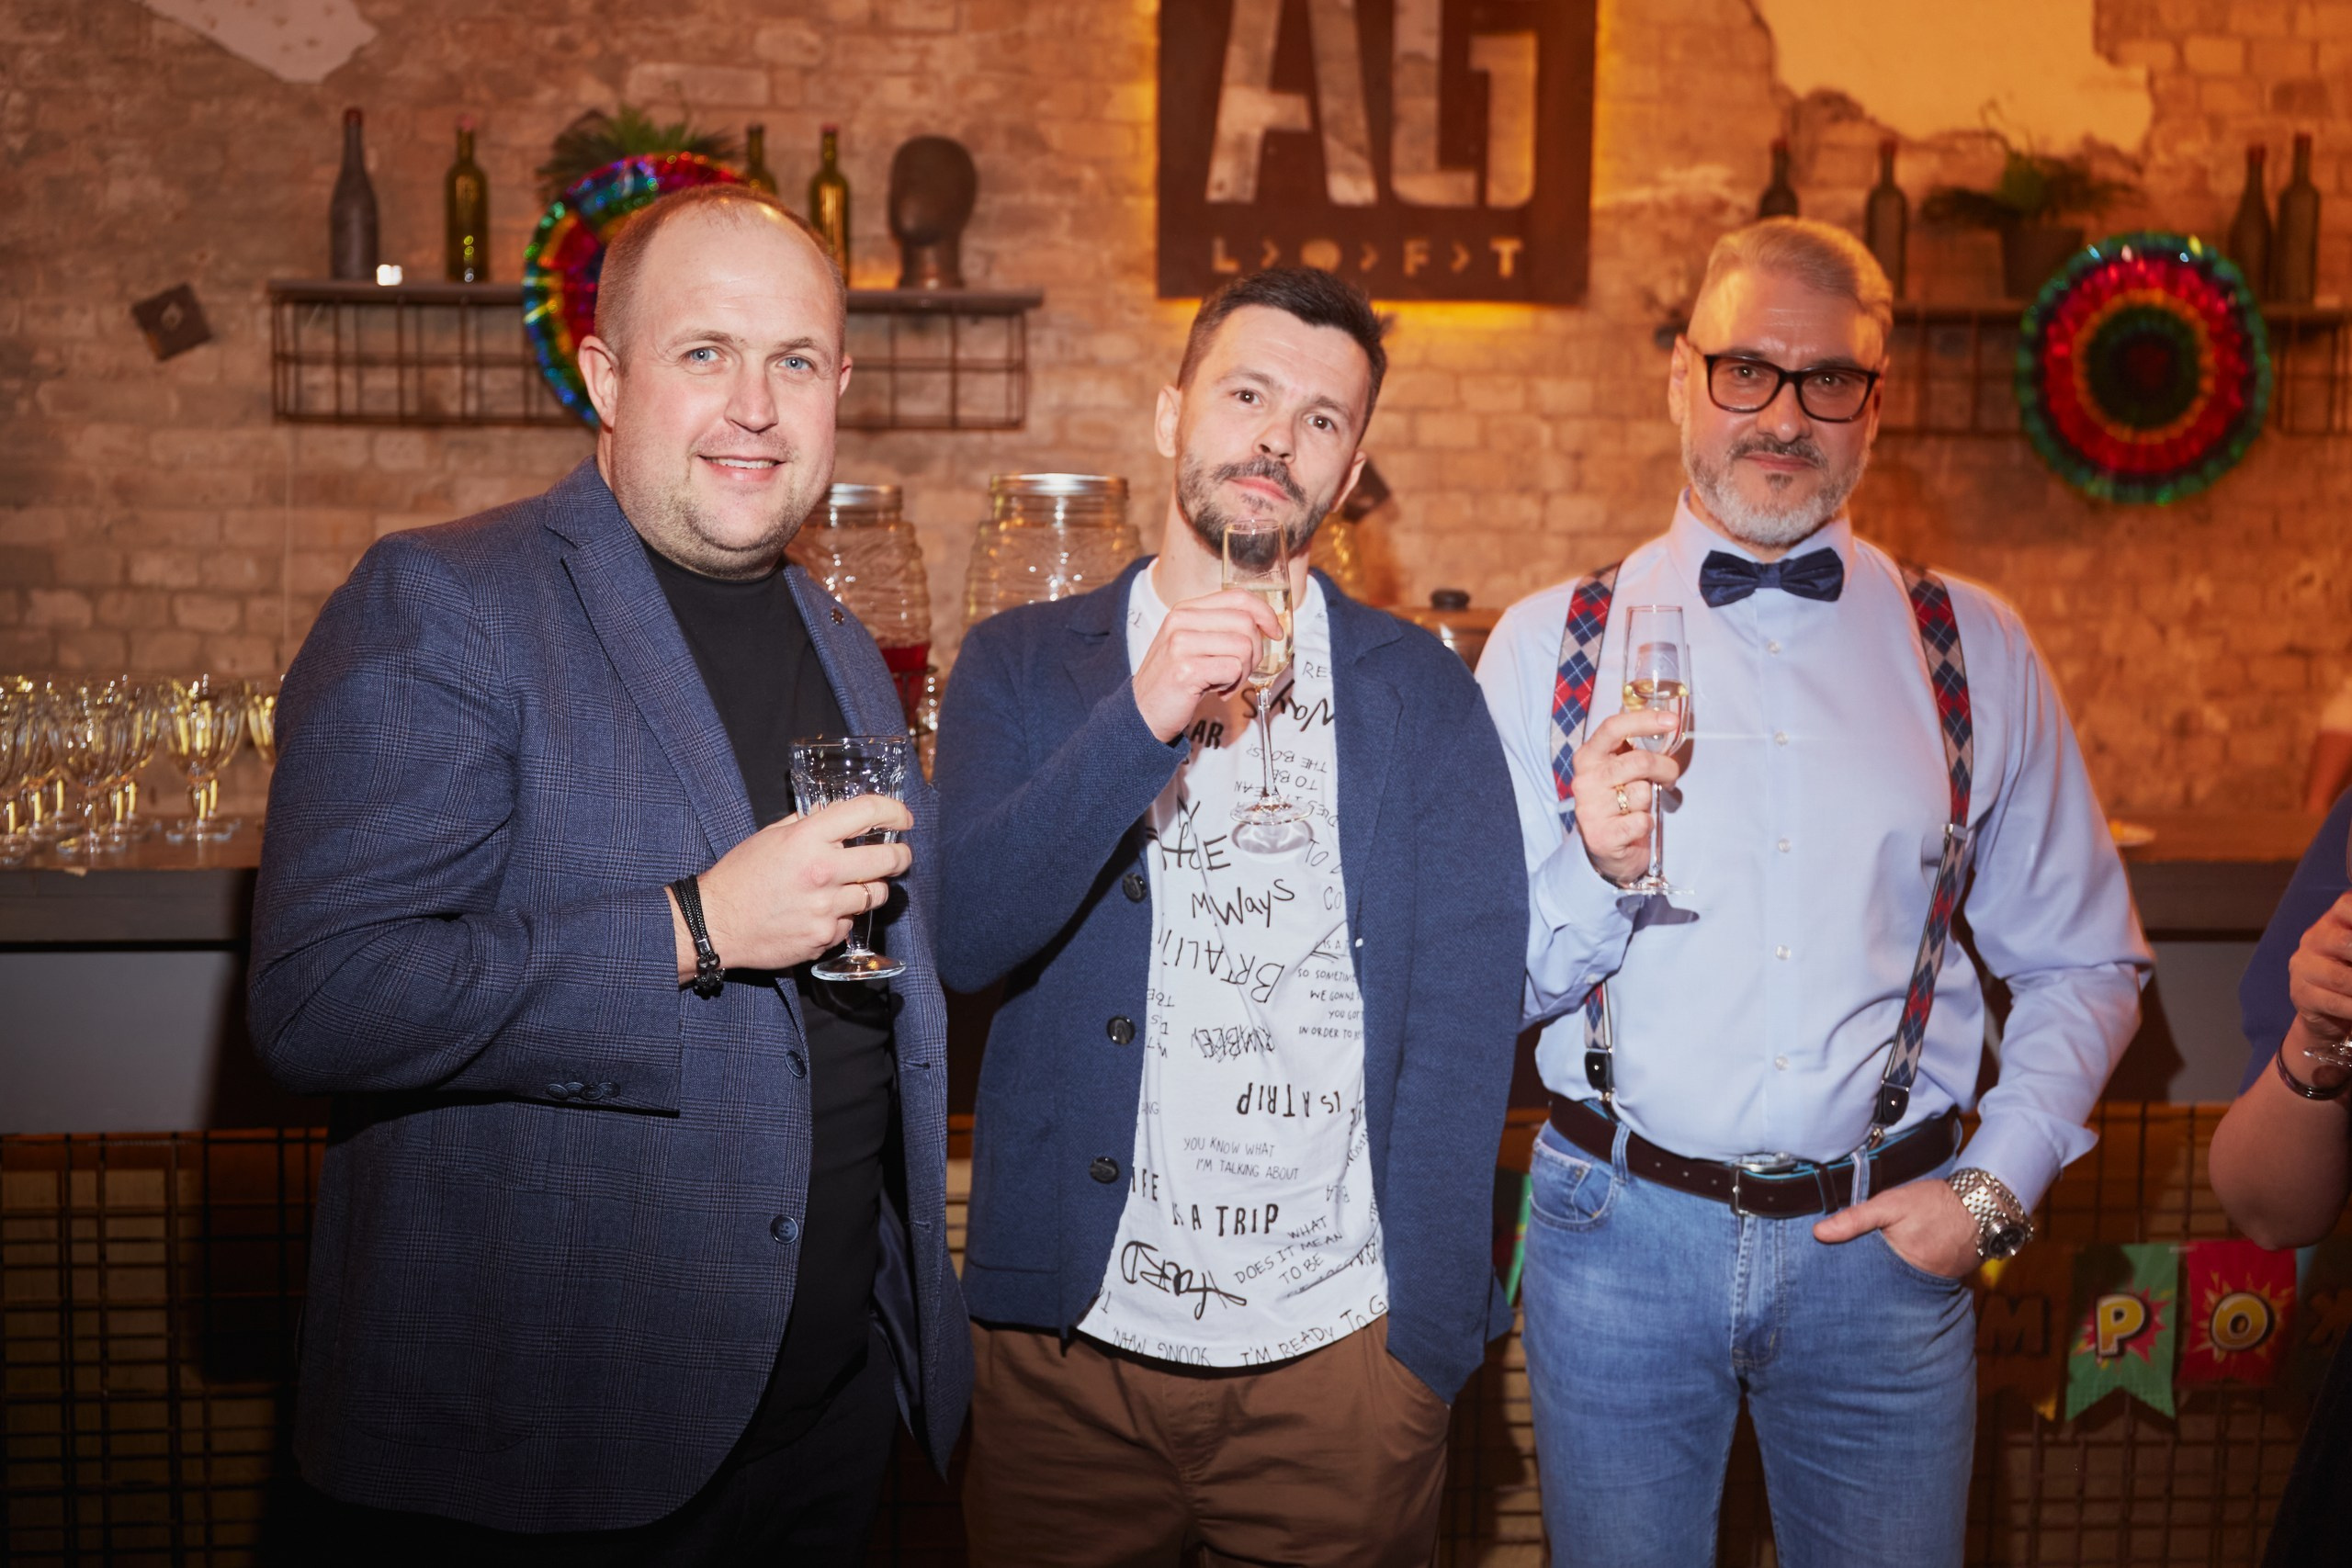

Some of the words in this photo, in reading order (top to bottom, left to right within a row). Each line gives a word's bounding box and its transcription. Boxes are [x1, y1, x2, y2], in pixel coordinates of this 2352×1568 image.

[1297, 968, 1310, 978] SO
[1310, 990, 1326, 1002] WE
[1329, 992, 1354, 1003] GONNA
[1329, 1010, 1344, 1021] YOU
[1298, 1026, 1309, 1036] IN
[1311, 1028, 1339, 1039] ORDER
[1343, 1030, 1351, 1041] TO
[1237, 1082, 1295, 1118] TRIP
[1183, 1136, 1205, 1151] YOU
[1209, 1135, 1240, 1155] KNOW
[1245, 1142, 1275, 1158] WHAT
[1195, 1157, 1213, 1172] I'M
[1220, 1159, 1260, 1178] TALKING
[1265, 1166, 1299, 1180] ABOUT
[1192, 1203, 1203, 1231] A
[1216, 1203, 1280, 1237] TRIP
[1287, 1215, 1327, 1239] WHAT
[1233, 1256, 1275, 1285] DOES
[1276, 1245, 1295, 1263] IT
[1300, 1231, 1342, 1252] MEAN
[1278, 1266, 1302, 1285] TO
[1303, 1251, 1324, 1273] BE
